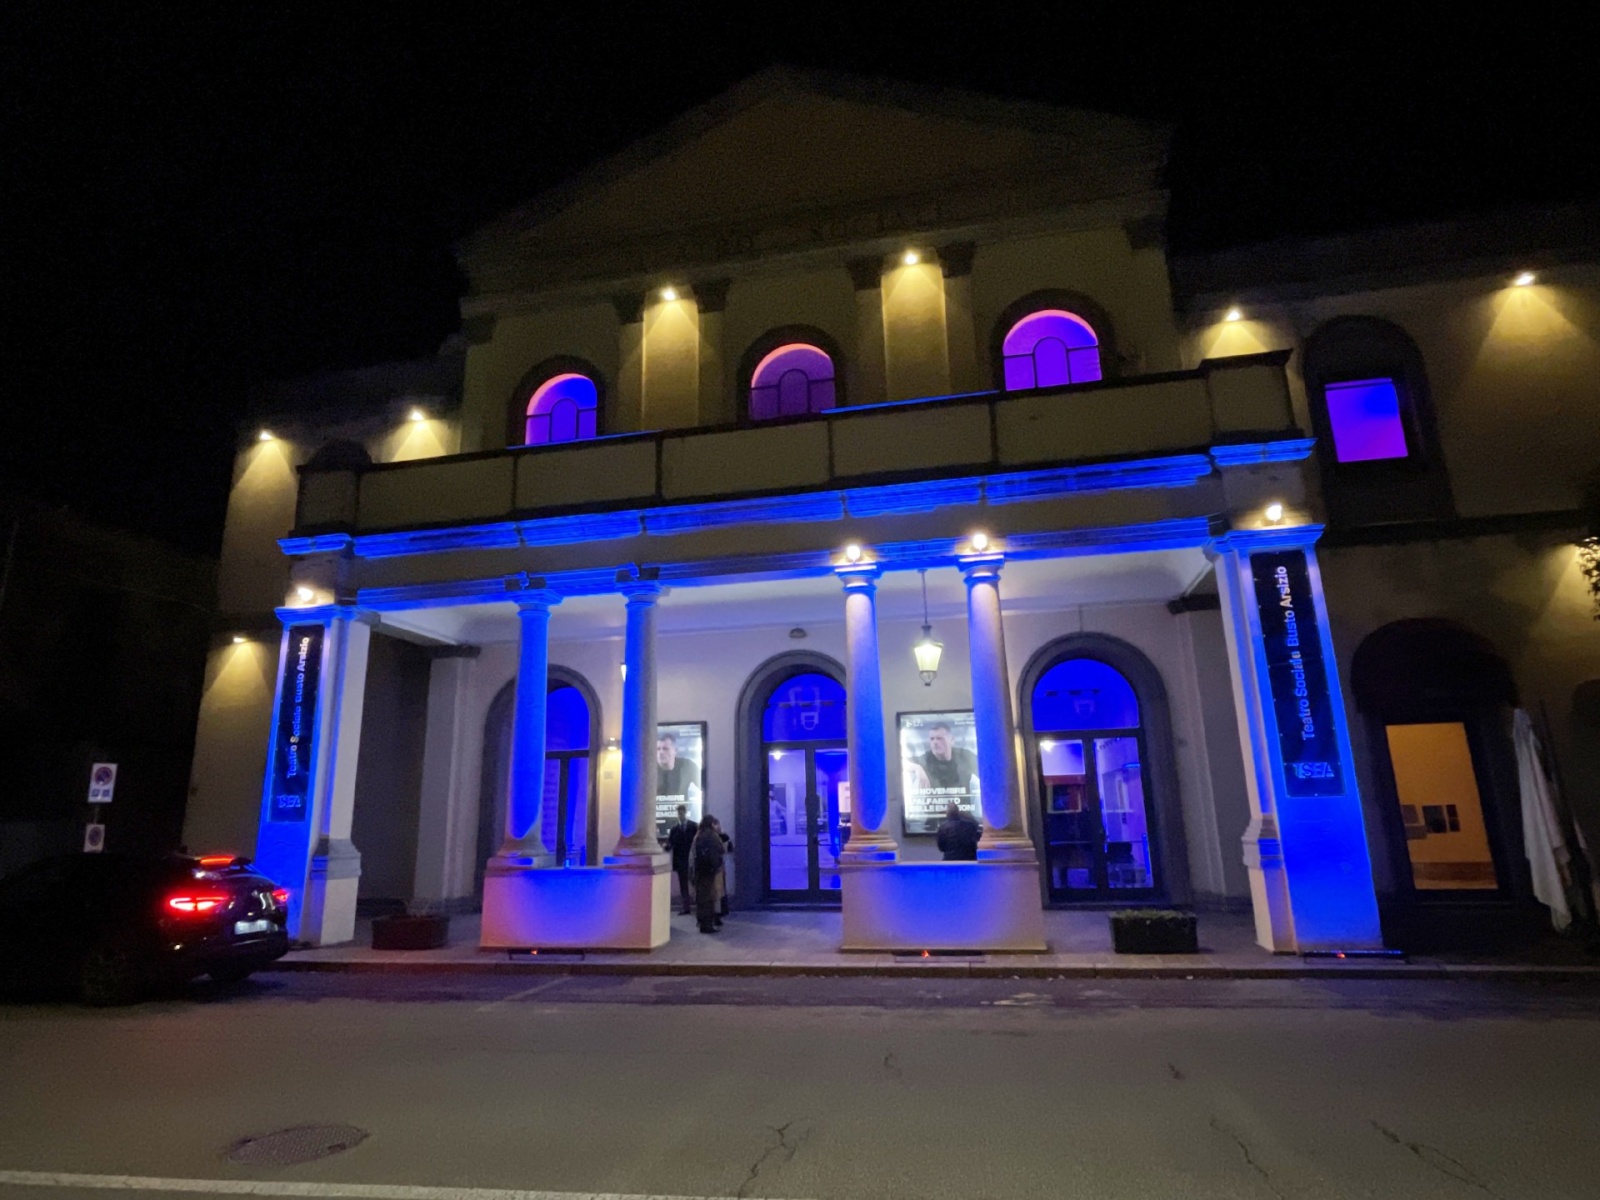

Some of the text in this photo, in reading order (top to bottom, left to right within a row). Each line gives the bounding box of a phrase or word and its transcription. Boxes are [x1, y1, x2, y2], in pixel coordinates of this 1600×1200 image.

[297, 637, 310, 671] Arsizio
[1274, 566, 1315, 740] Teatro Sociale Busto Arsizio
[920, 787, 966, 795] NOVEMBRE
